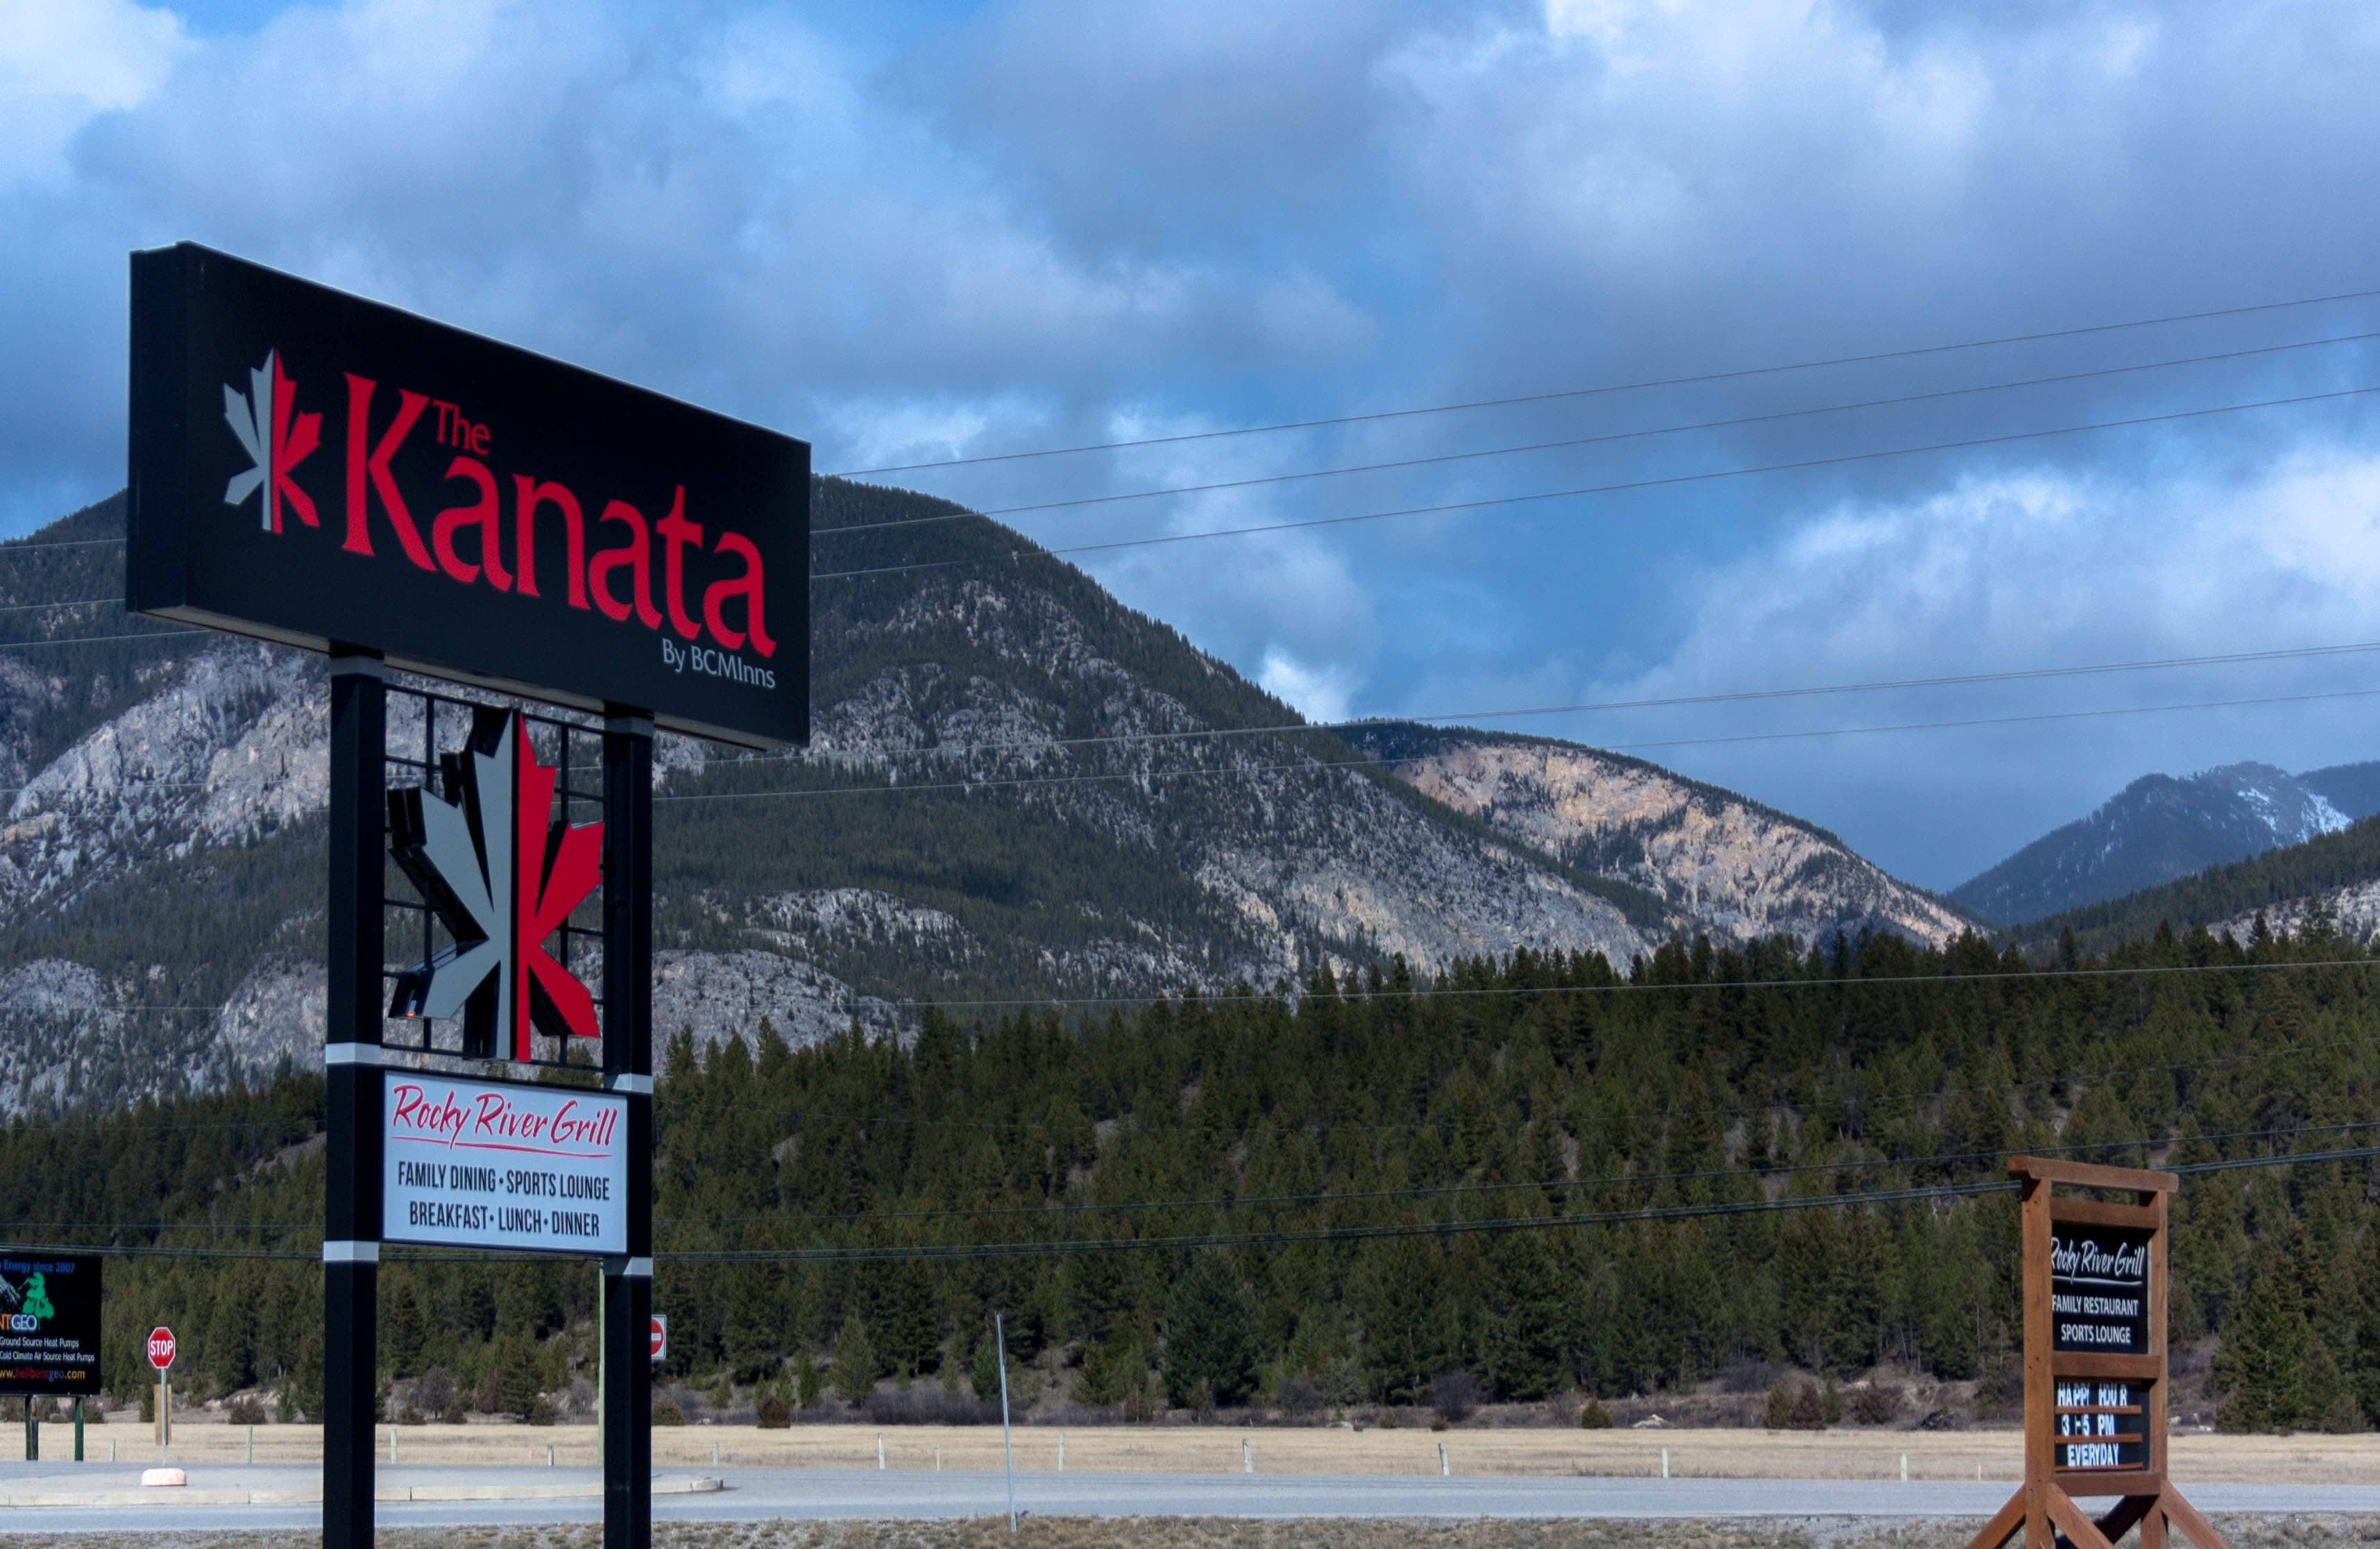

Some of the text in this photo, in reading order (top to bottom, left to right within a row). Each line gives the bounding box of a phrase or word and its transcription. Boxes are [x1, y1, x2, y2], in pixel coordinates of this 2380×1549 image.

[432, 398, 491, 455] The
[341, 371, 776, 659] Kanata
[662, 638, 776, 689] By BCMInns
[393, 1084, 618, 1151] Rocky River Grill
[398, 1161, 610, 1201] FAMILY DINING SPORTS LOUNGE
[409, 1201, 600, 1237] BREAKFAST LUNCH DINNER
[3, 1260, 31, 1273] Energy
[33, 1262, 53, 1272] since
[56, 1262, 76, 1273] 2007
[2051, 1237, 2145, 1285] Rocky River Grill
[2052, 1294, 2139, 1316] FAMILY RESTAURANT
[0, 1336, 80, 1349] Ground Source Heat Pumps
[2061, 1323, 2131, 1344] SPORTS LOUNGE
[0, 1351, 12, 1360] Cold
[12, 1351, 33, 1360] Climate
[43, 1351, 62, 1361] Source
[63, 1352, 76, 1361] Heat
[76, 1352, 95, 1363] Pumps
[150, 1340, 173, 1355] STOP
[2097, 1413, 2115, 1437] PM
[2066, 1443, 2119, 1466] EVERYDAY
